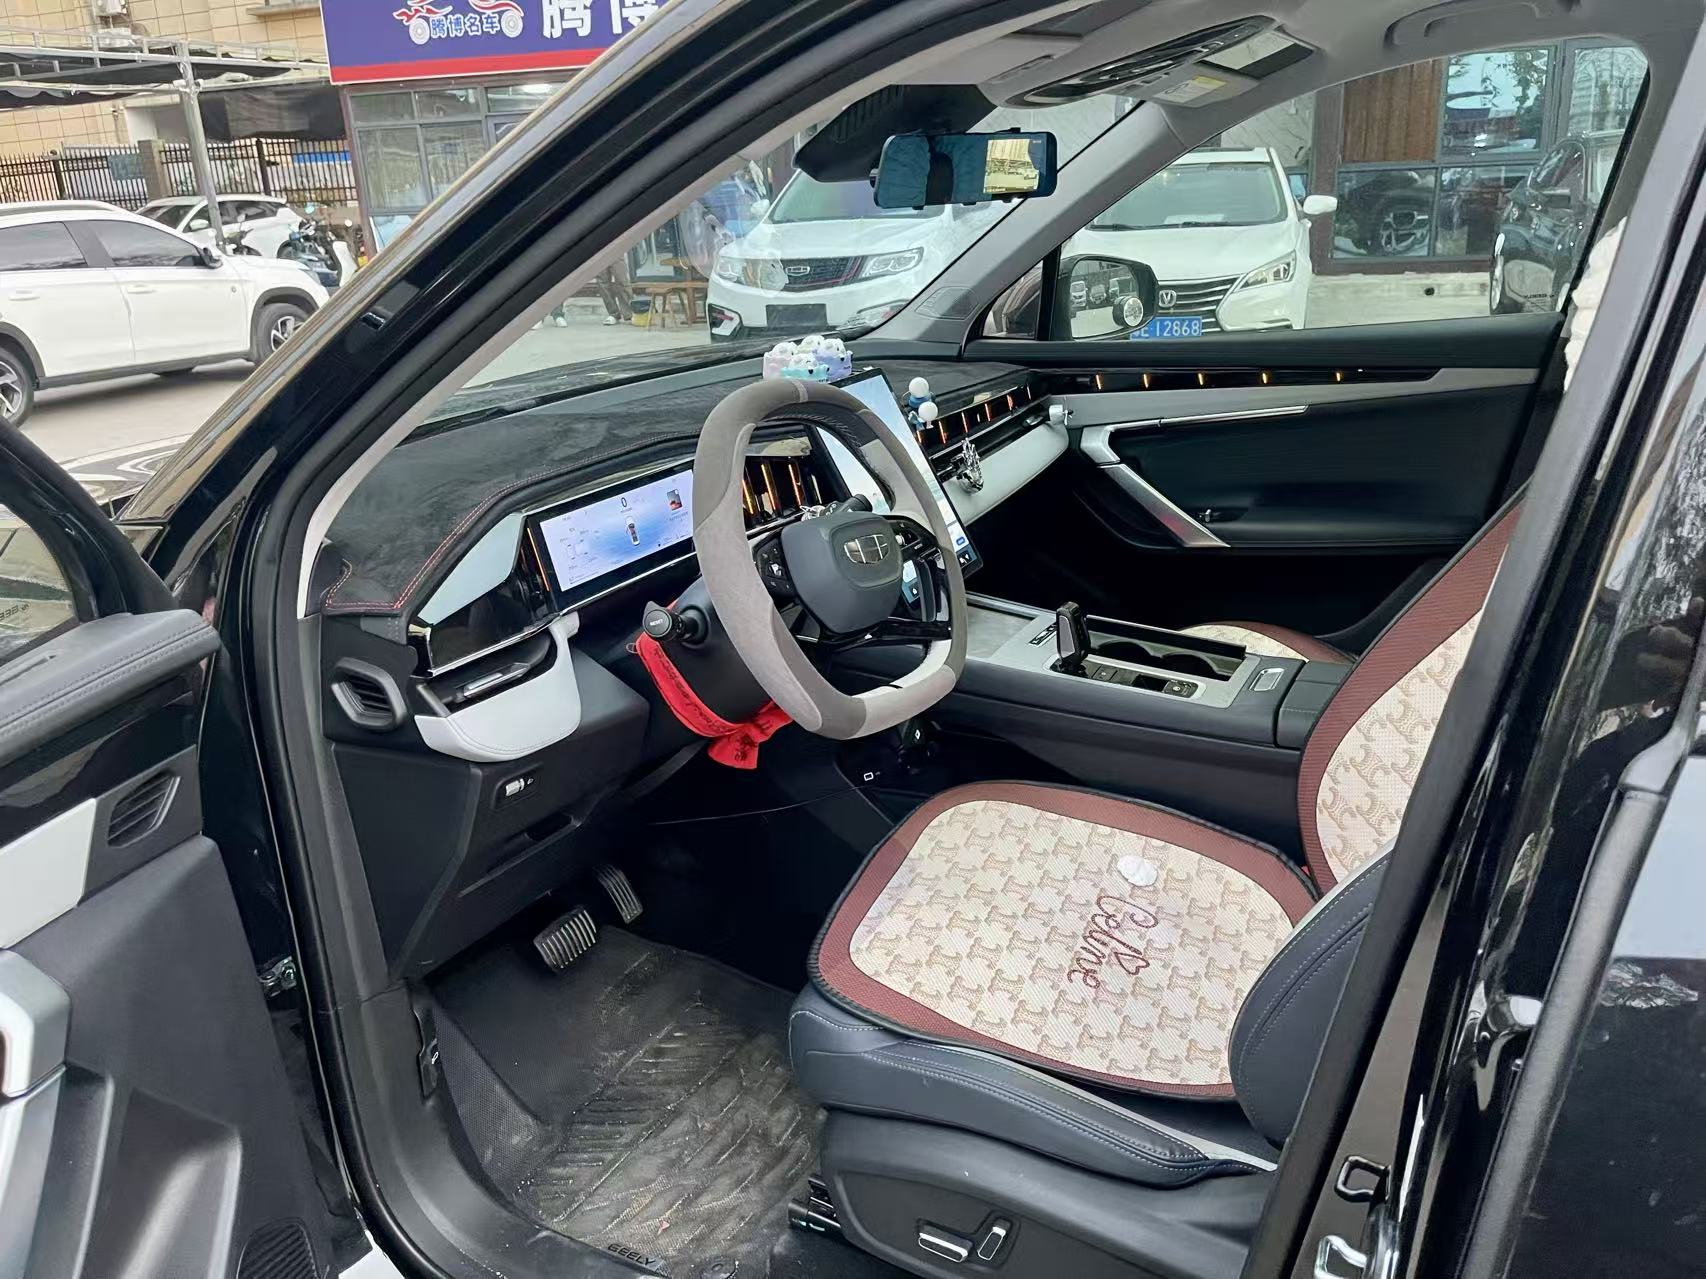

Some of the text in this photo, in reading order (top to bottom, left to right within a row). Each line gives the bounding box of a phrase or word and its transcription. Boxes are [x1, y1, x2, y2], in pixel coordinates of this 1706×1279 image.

[430, 13, 501, 39] 腾博名车
[606, 1243, 656, 1266] GEELY
